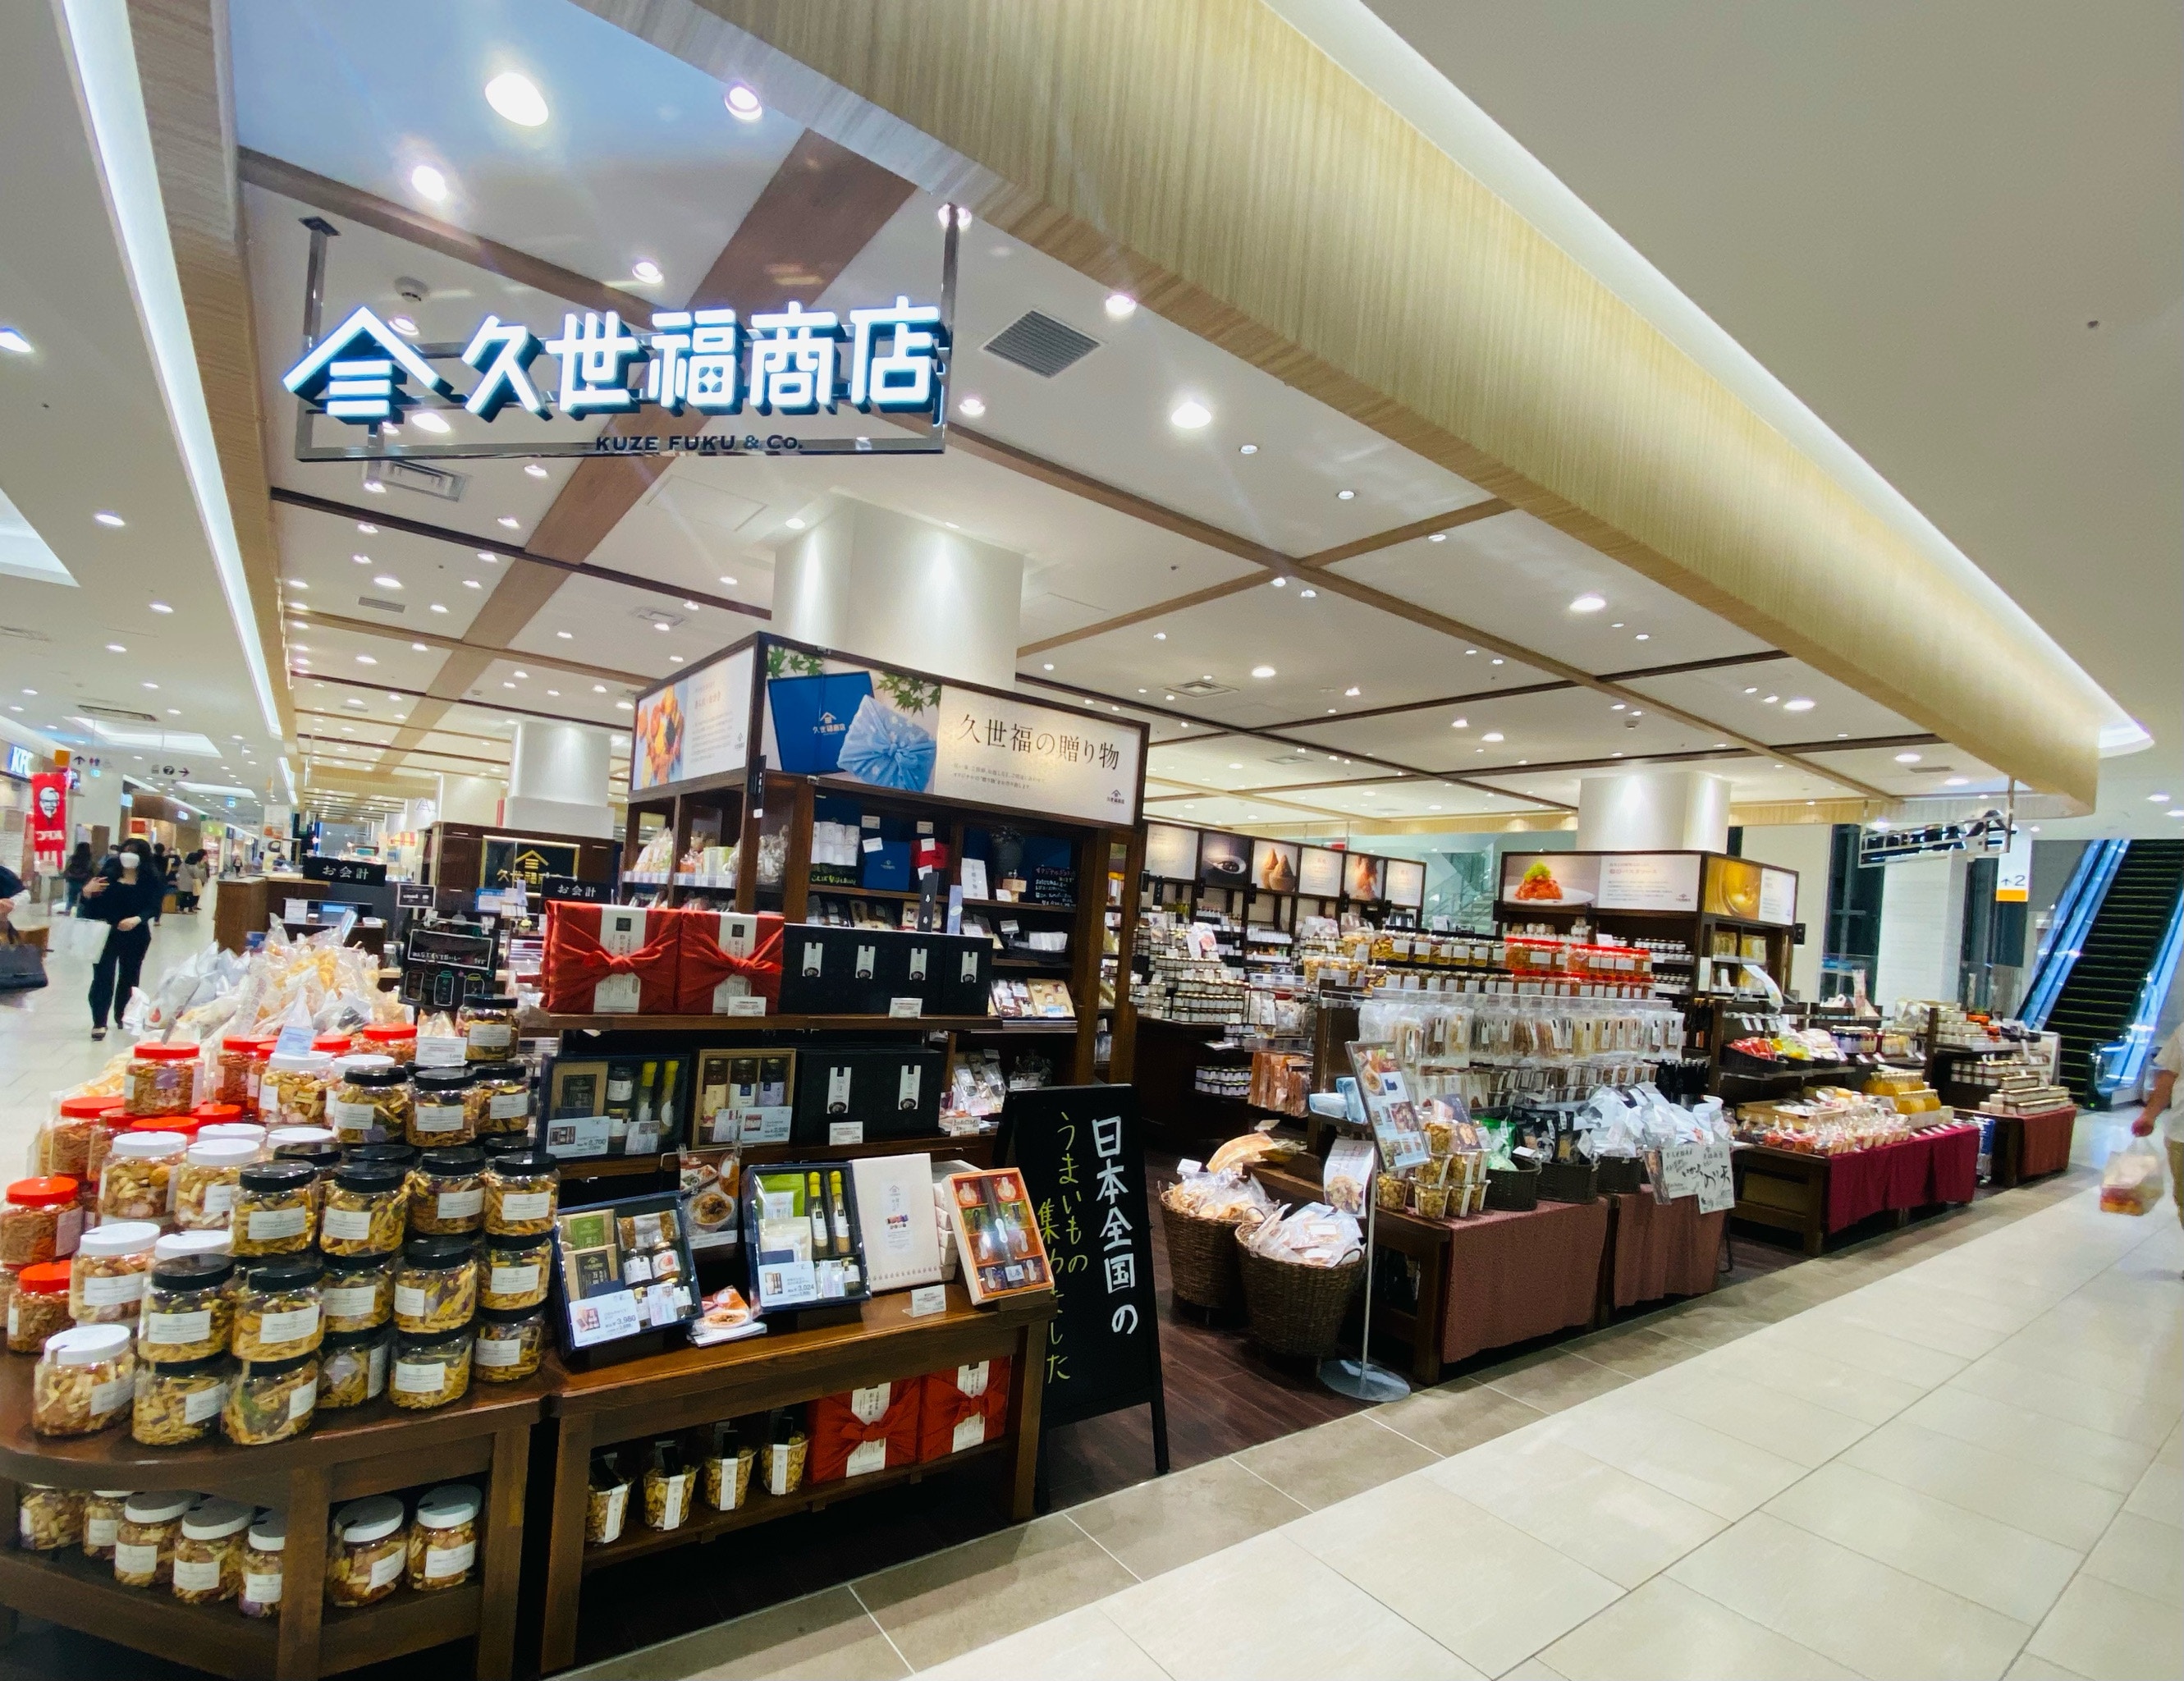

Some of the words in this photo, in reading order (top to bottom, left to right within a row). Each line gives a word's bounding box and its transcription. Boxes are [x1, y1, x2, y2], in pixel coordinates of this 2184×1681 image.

[461, 295, 943, 416] 久世福商店
[596, 436, 659, 451] KUZE
[668, 435, 735, 451] FUKU
[744, 434, 759, 450] &
[767, 434, 804, 450] Co.
[957, 713, 1120, 771] 久世福の贈り物
[11, 746, 34, 776] KFC
[322, 865, 369, 881] お会計
[2014, 874, 2026, 886] 2
[557, 884, 597, 898] お会計
[1057, 1111, 1088, 1272] うまいもの
[1092, 1115, 1138, 1335] 日本全国の
